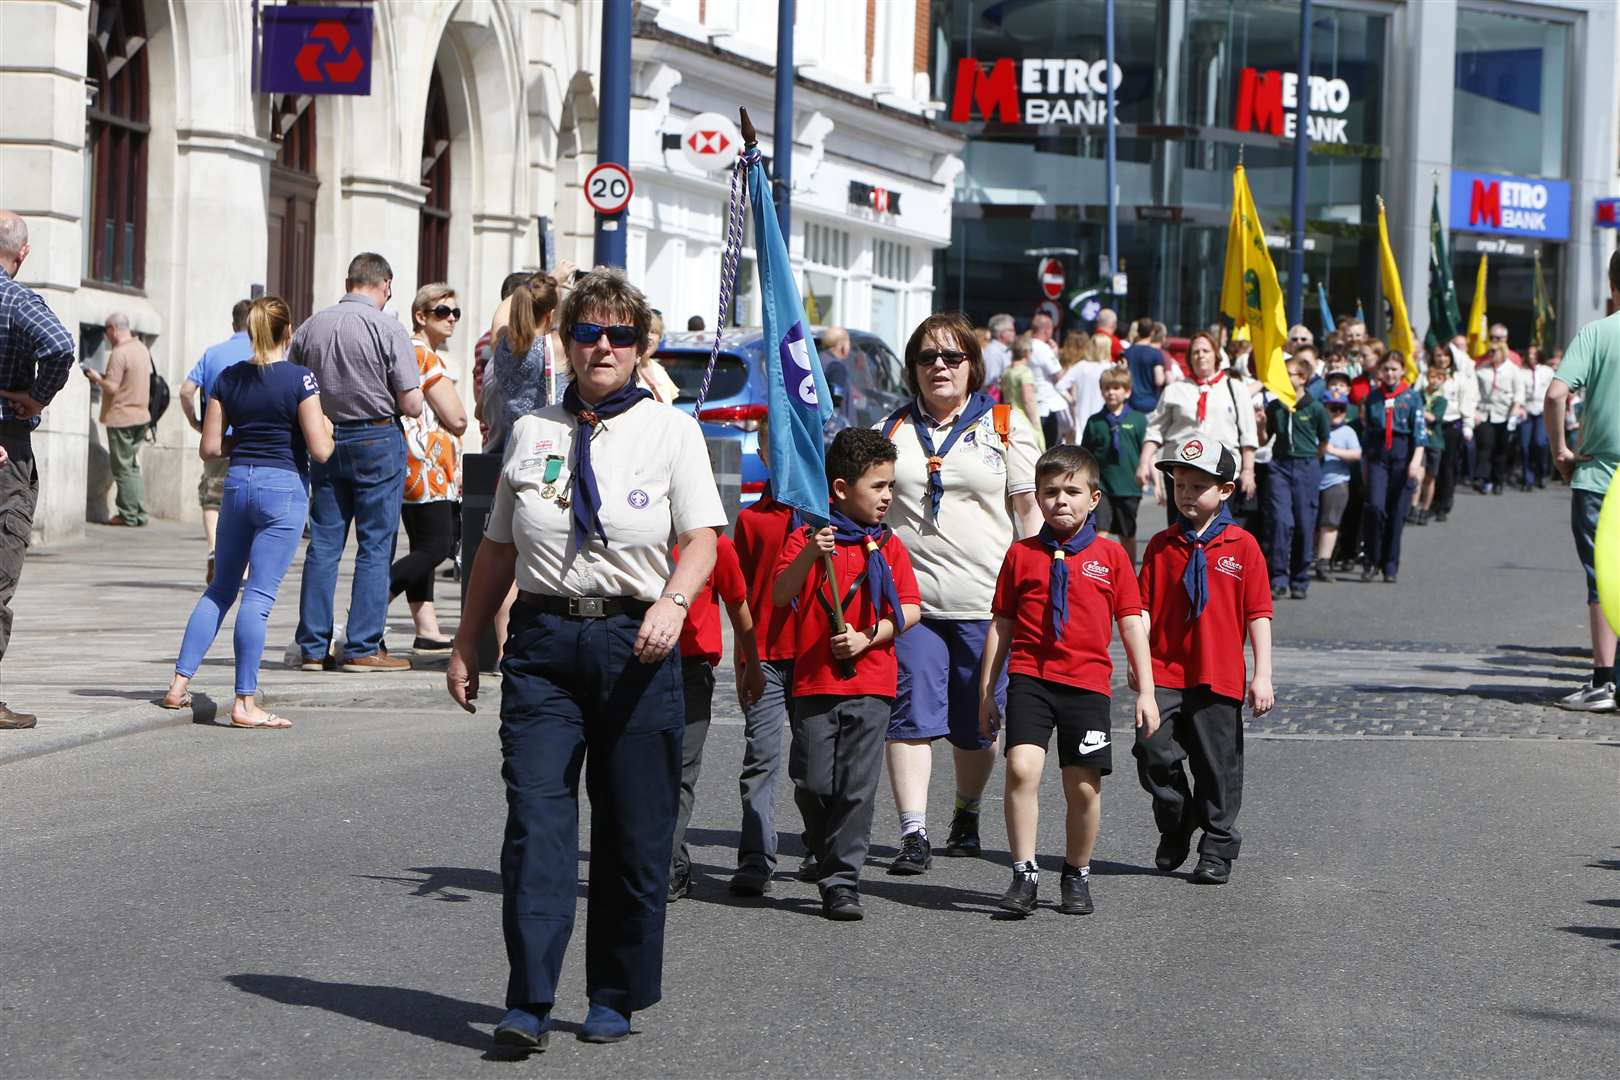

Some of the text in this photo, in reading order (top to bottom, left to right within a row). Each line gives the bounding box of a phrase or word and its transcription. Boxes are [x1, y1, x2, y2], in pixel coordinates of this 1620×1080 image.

[951, 58, 1123, 123] METRO
[1236, 67, 1350, 136] MERO
[1025, 99, 1120, 125] BANK
[593, 179, 626, 198] 20
[1471, 180, 1547, 226] METRO
[1502, 209, 1547, 231] BANK
[1084, 730, 1107, 745] NIKE
